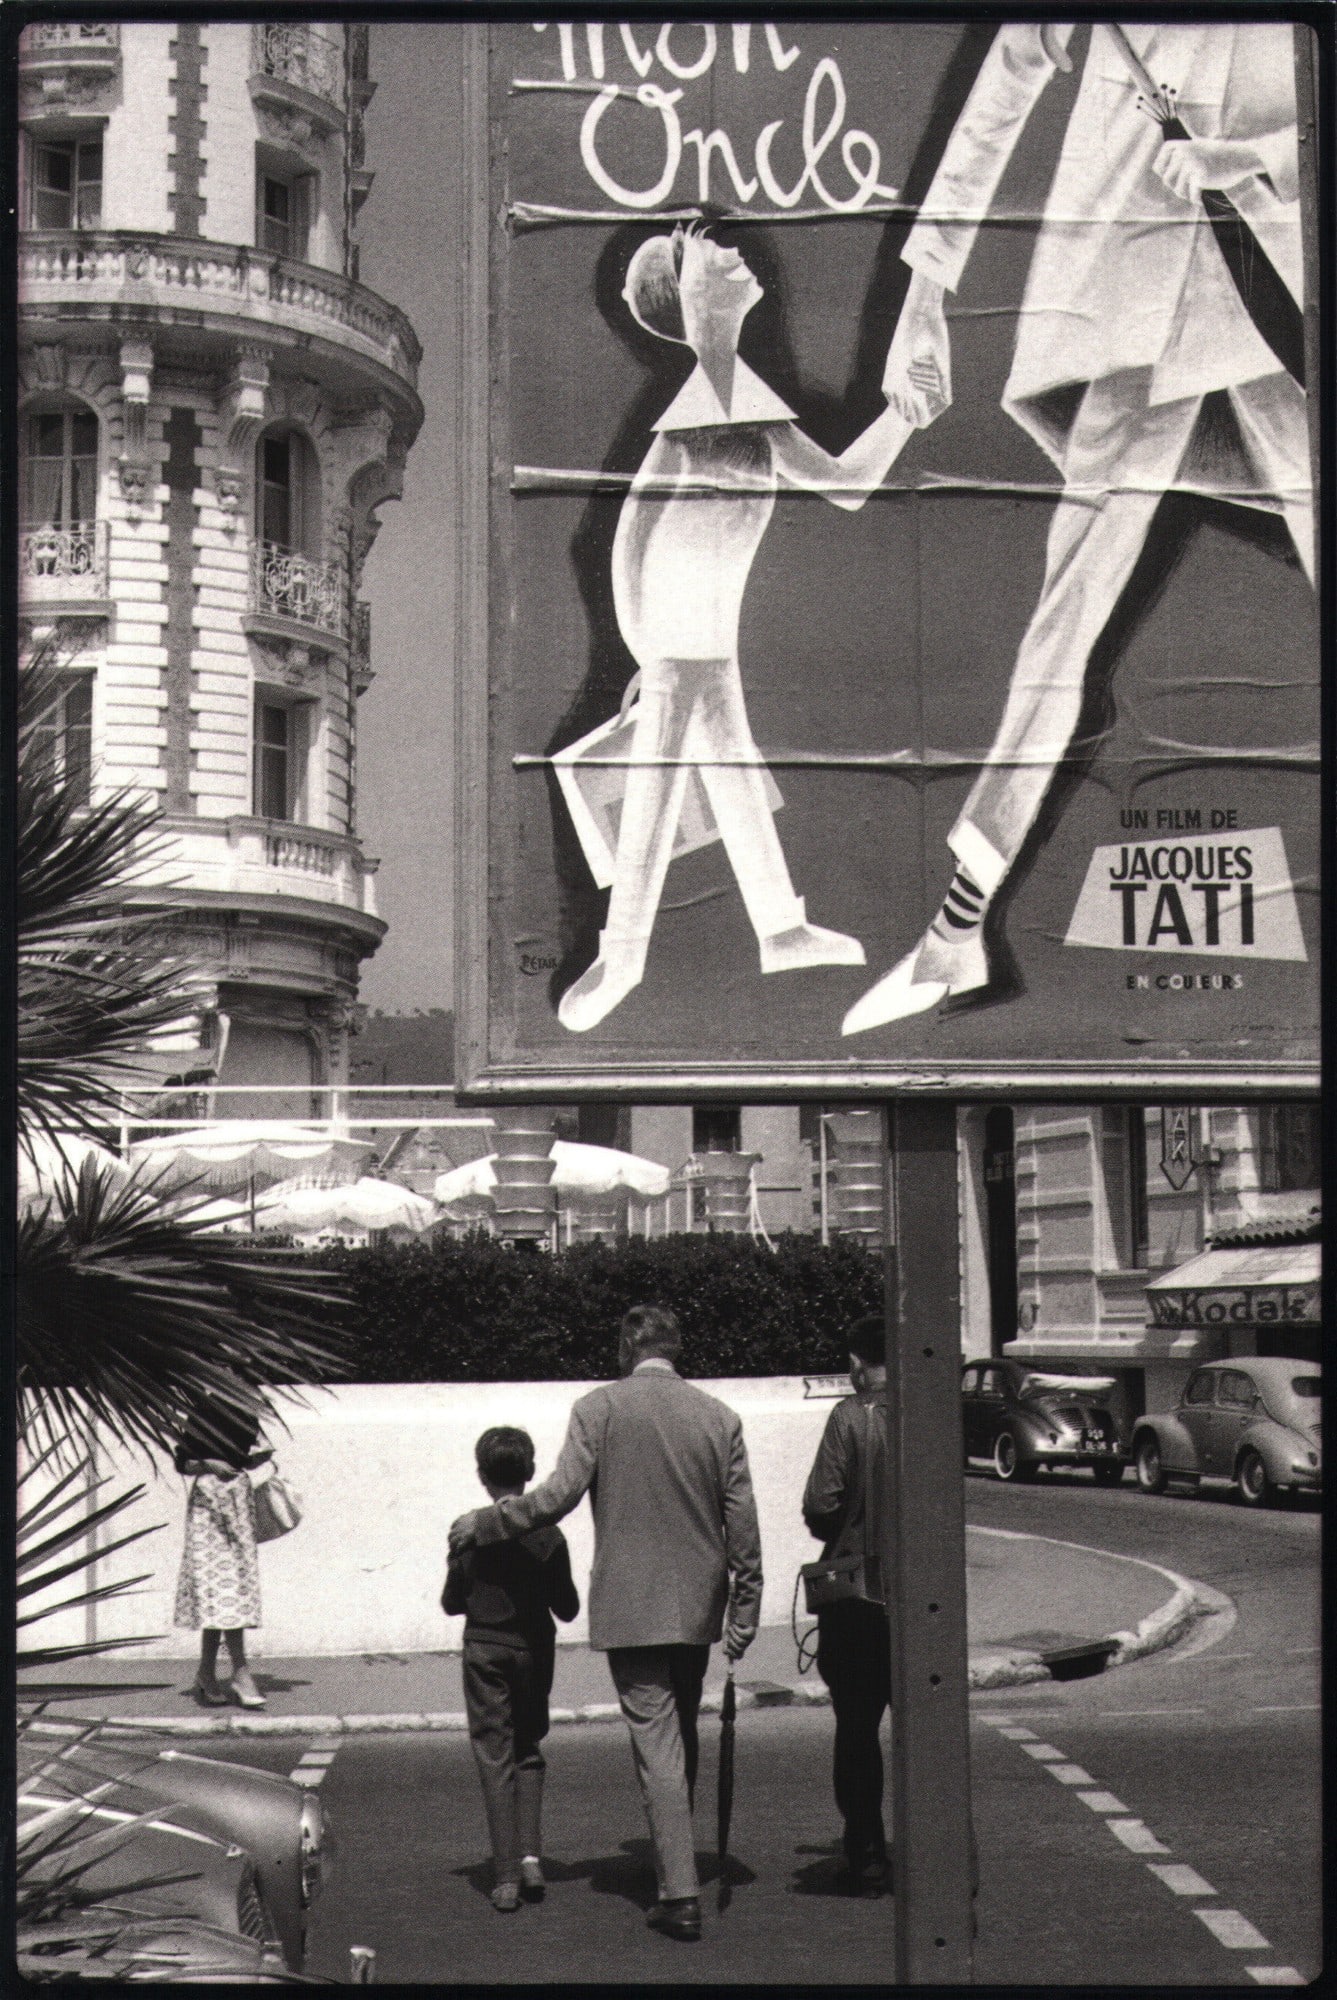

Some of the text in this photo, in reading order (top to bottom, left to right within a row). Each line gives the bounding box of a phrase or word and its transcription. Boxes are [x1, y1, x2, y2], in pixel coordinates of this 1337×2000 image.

[580, 58, 899, 211] Oncle
[1120, 809, 1238, 829] UN FILM DE
[1109, 846, 1254, 883] JACQUES
[1110, 883, 1255, 946] TATI
[1126, 974, 1244, 990] EN COULEURS
[1180, 1288, 1307, 1323] Kodak
